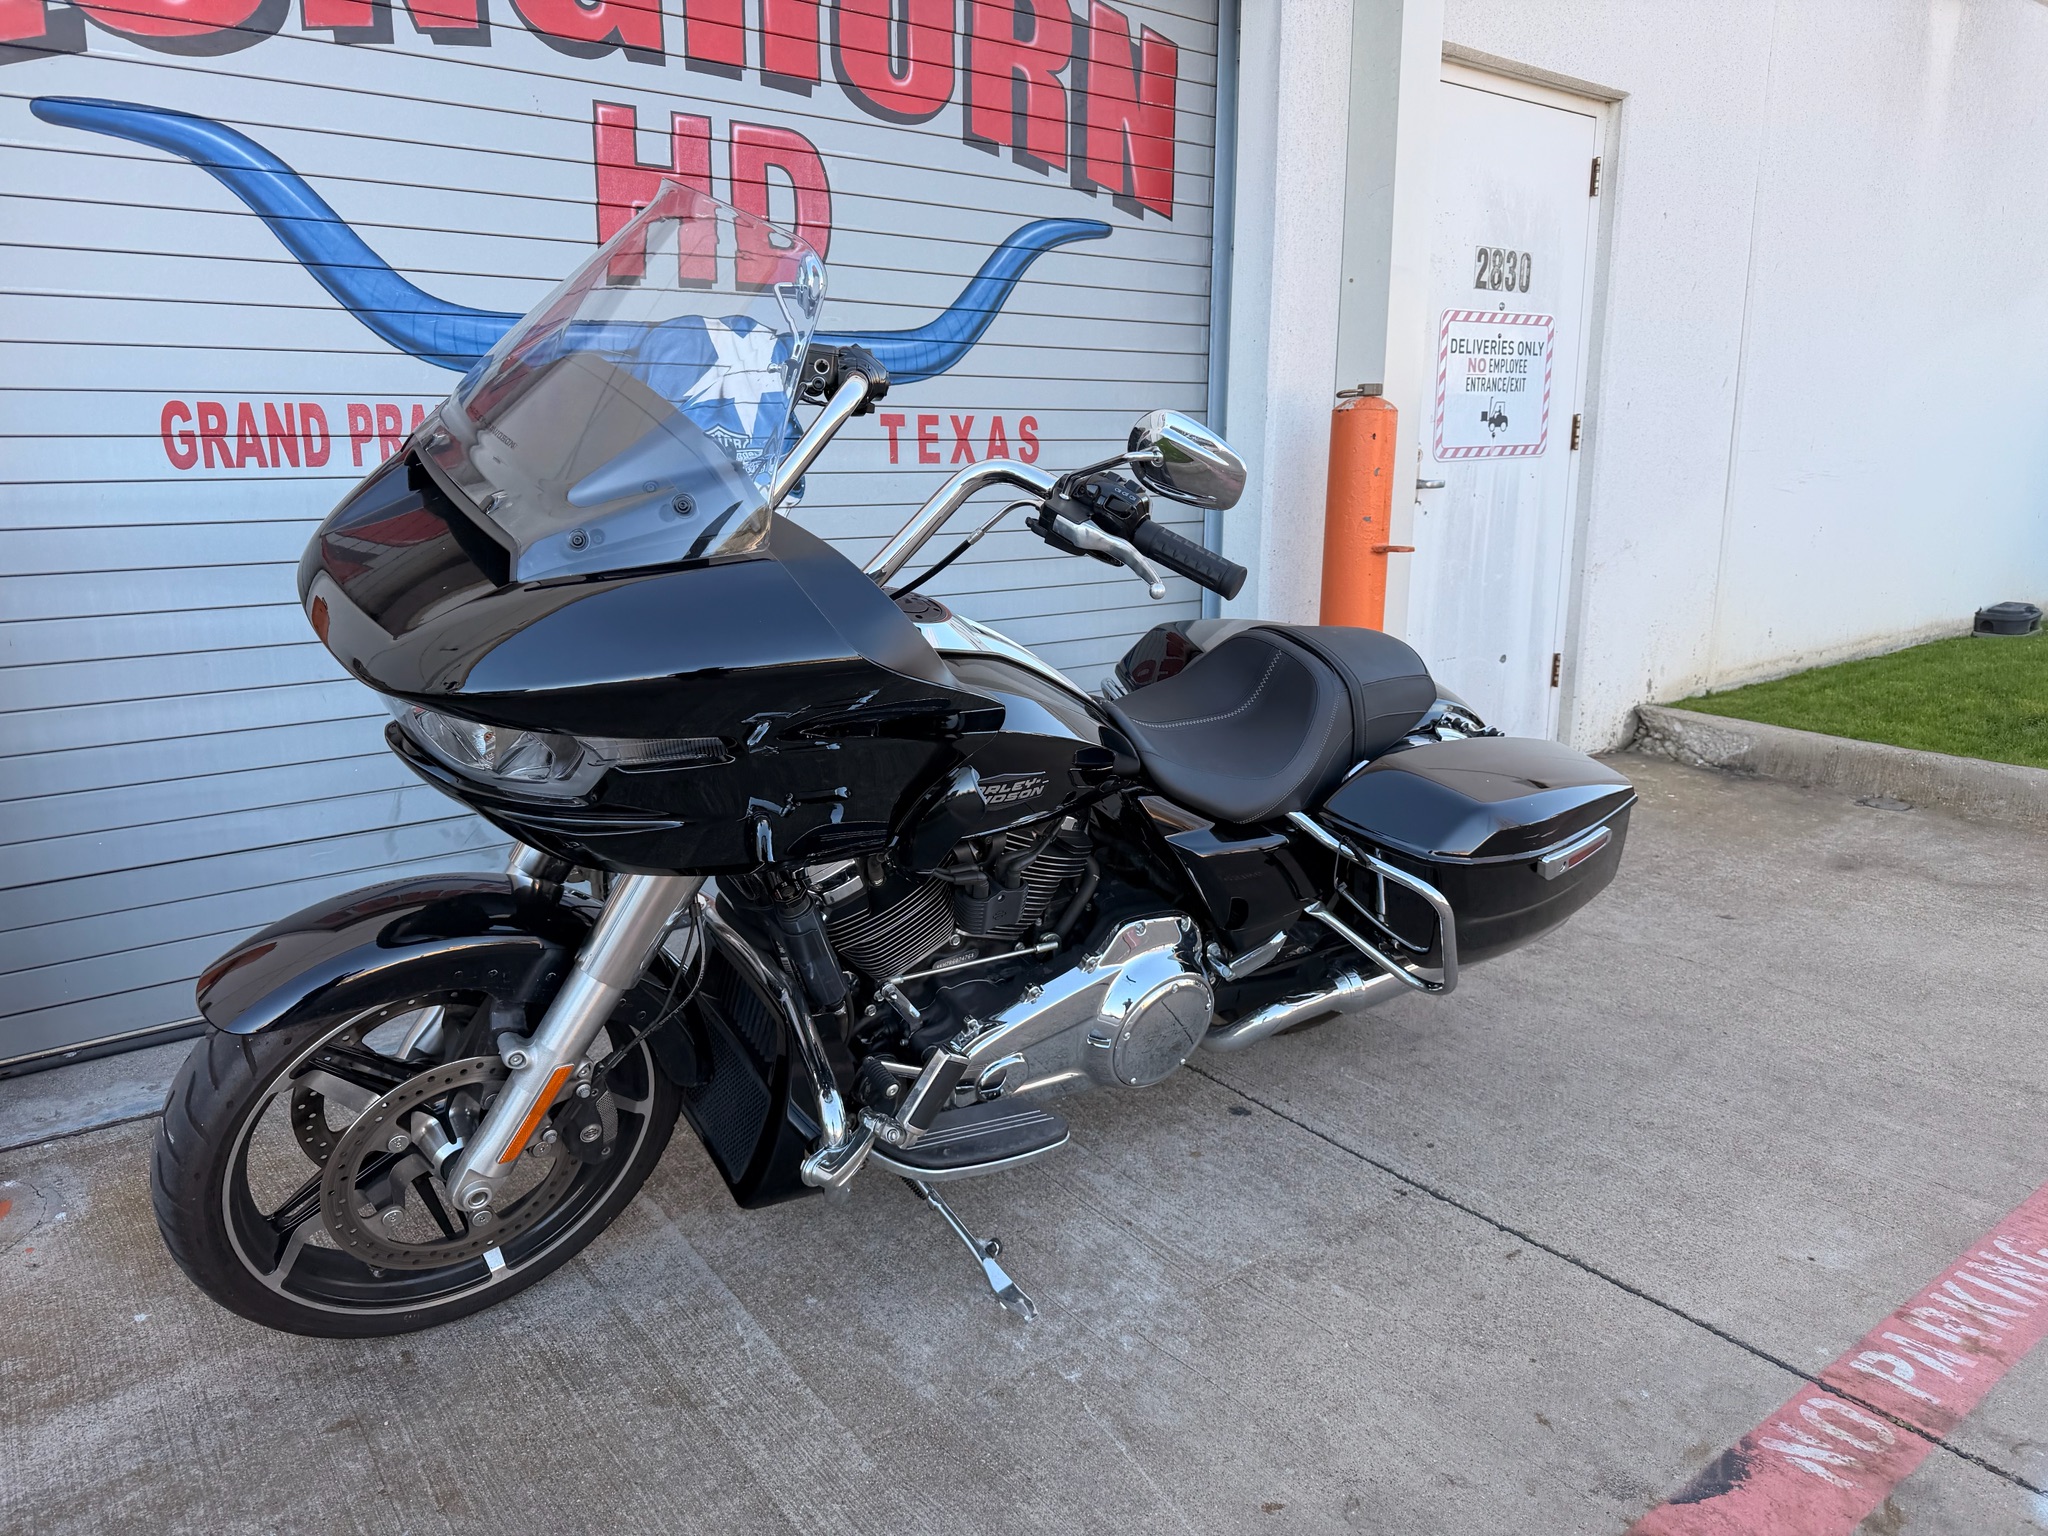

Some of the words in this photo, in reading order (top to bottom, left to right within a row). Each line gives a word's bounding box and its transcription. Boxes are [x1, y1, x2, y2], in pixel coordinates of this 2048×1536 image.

[593, 99, 833, 293] HD
[1475, 247, 1532, 293] 2830
[1450, 338, 1515, 356] DELIVERIES
[1518, 341, 1545, 357] ONLY
[1467, 358, 1487, 374] NO
[1489, 358, 1528, 374] EMPLOYEE
[1465, 377, 1527, 393] ENTRANCE/EXIT
[161, 400, 331, 470] GRAND
[880, 413, 1040, 465] TEXAS
[1758, 1397, 1896, 1489] NO
[1850, 1234, 2048, 1404] PARKING
